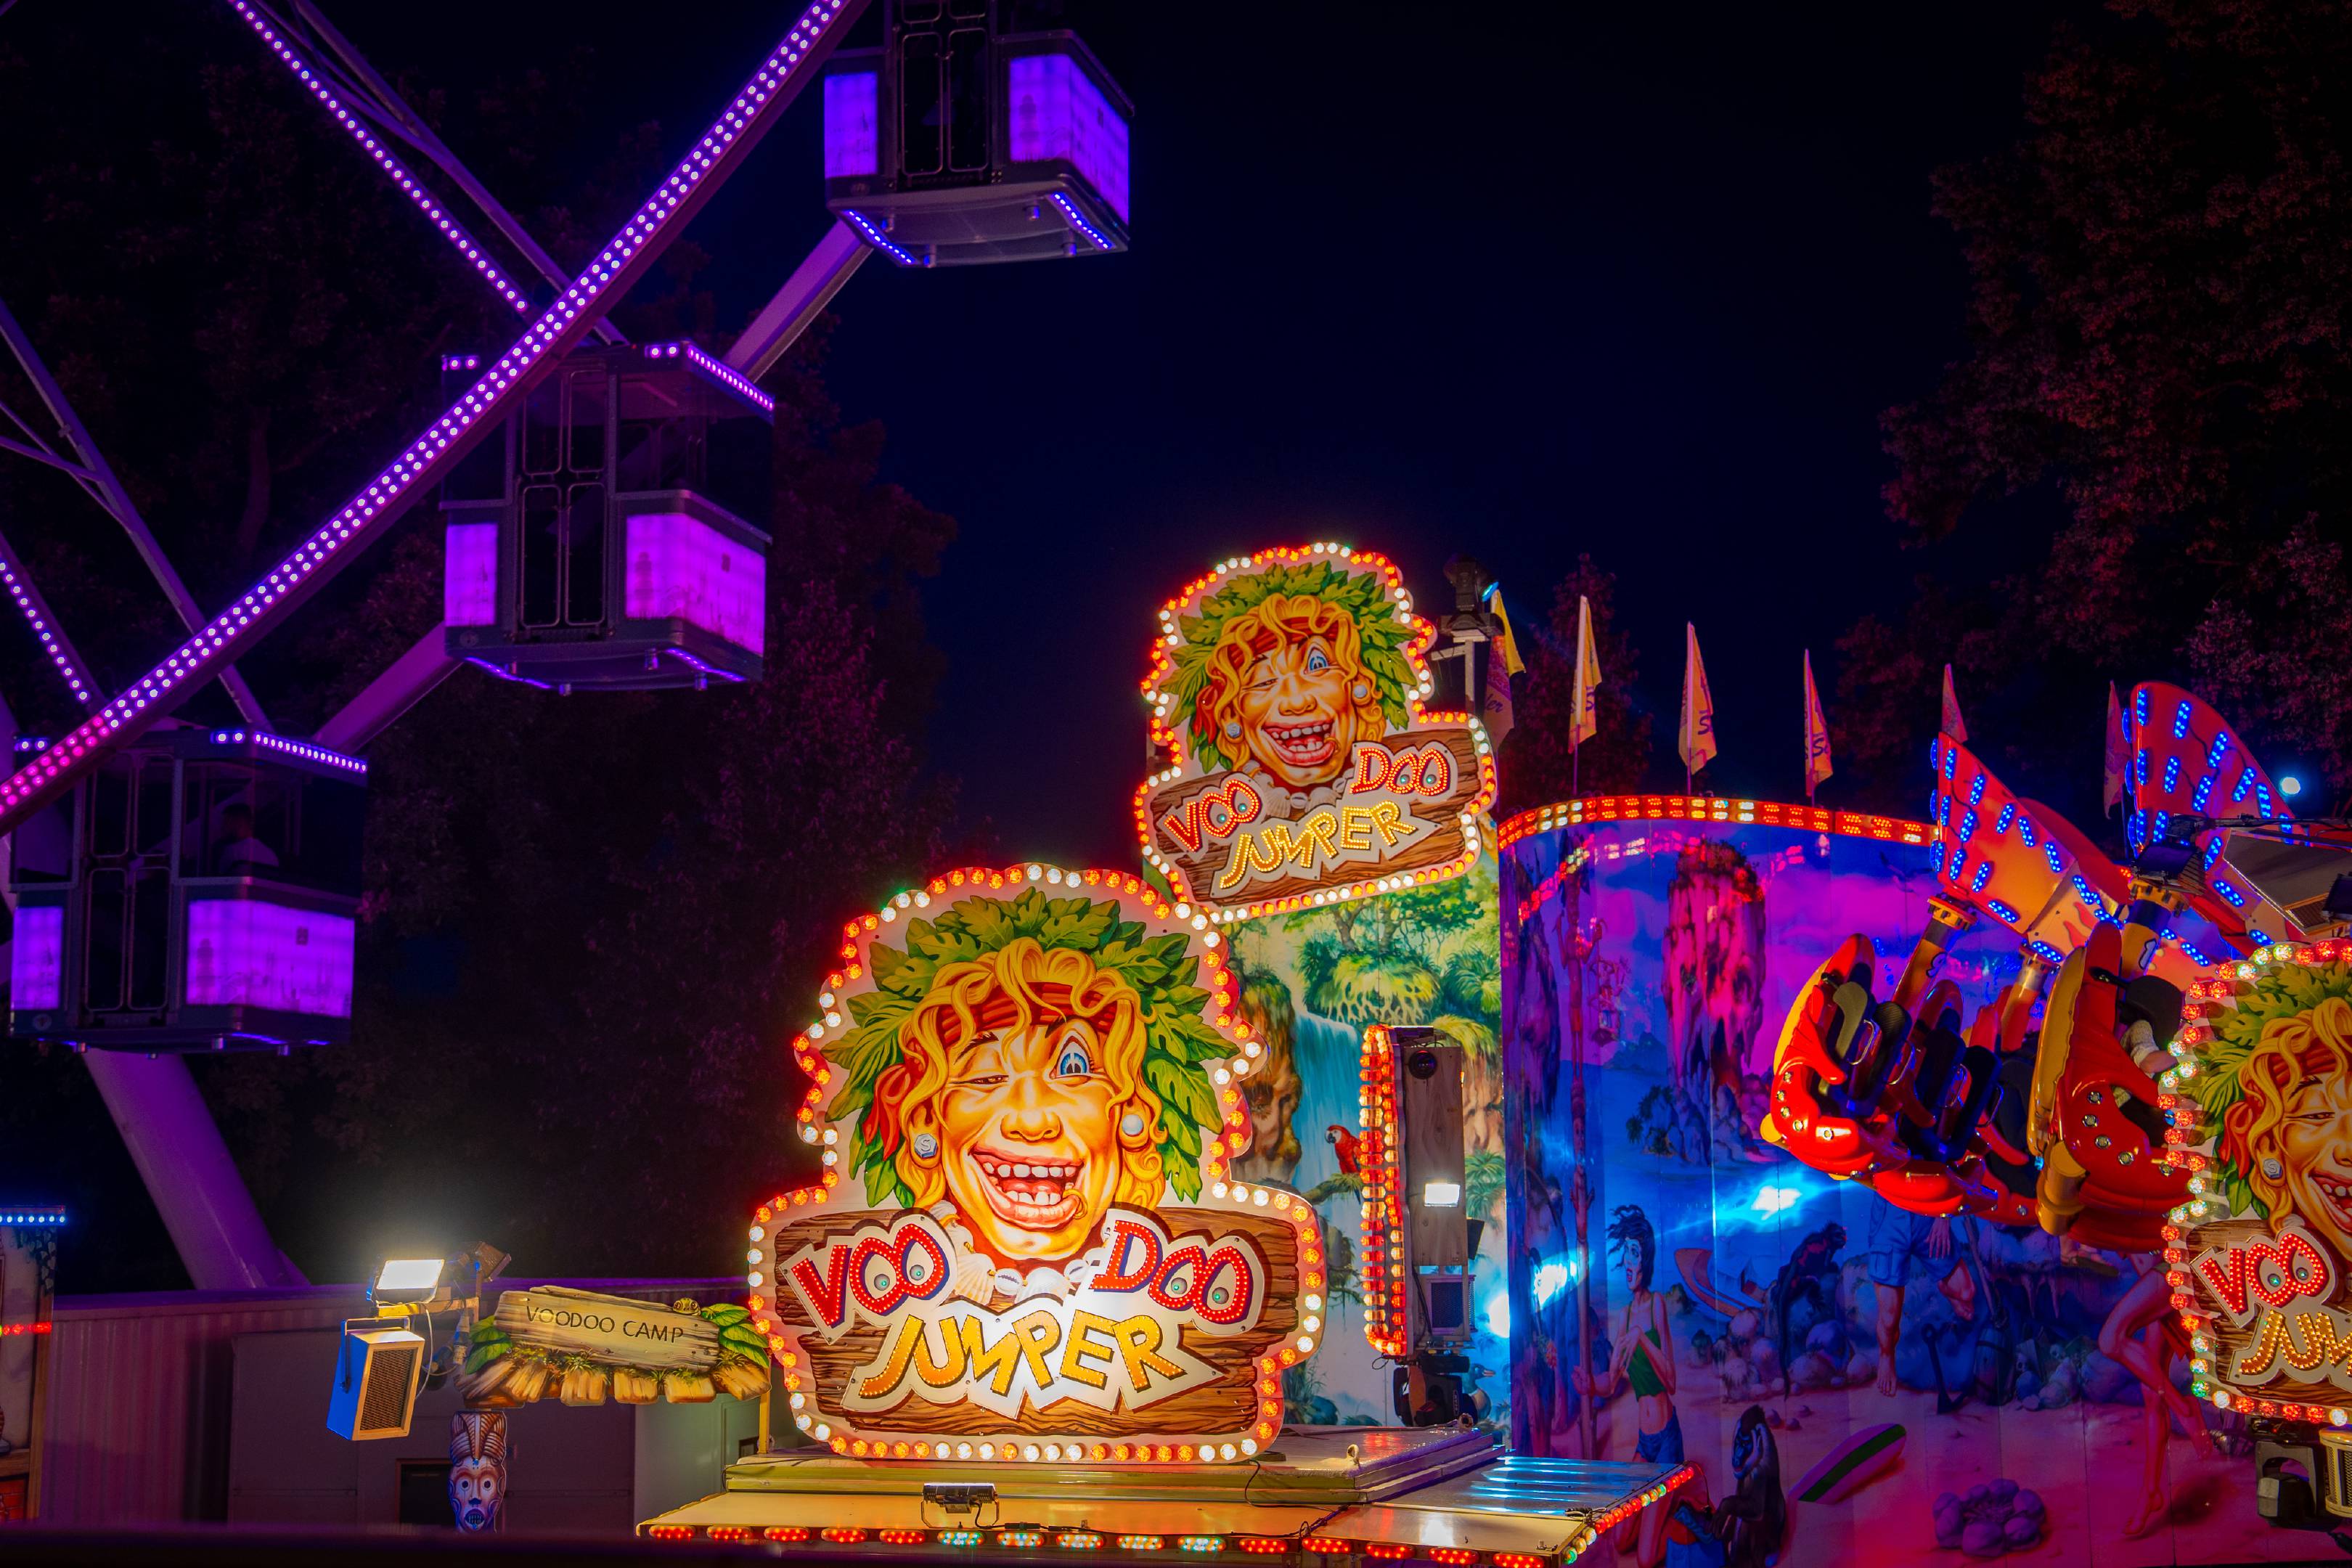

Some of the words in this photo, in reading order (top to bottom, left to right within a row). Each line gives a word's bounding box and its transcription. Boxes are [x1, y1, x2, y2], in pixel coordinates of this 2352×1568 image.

[1164, 778, 1262, 853] VOO
[1349, 747, 1452, 797] DOO
[1219, 800, 1417, 889] JUMPER
[791, 1221, 949, 1328] VOO
[1089, 1219, 1257, 1324] DOO
[2199, 1233, 2330, 1315] VOO
[526, 1304, 616, 1334] VOODOO
[623, 1320, 684, 1344] CAMP
[859, 1309, 1188, 1399] JUMPER
